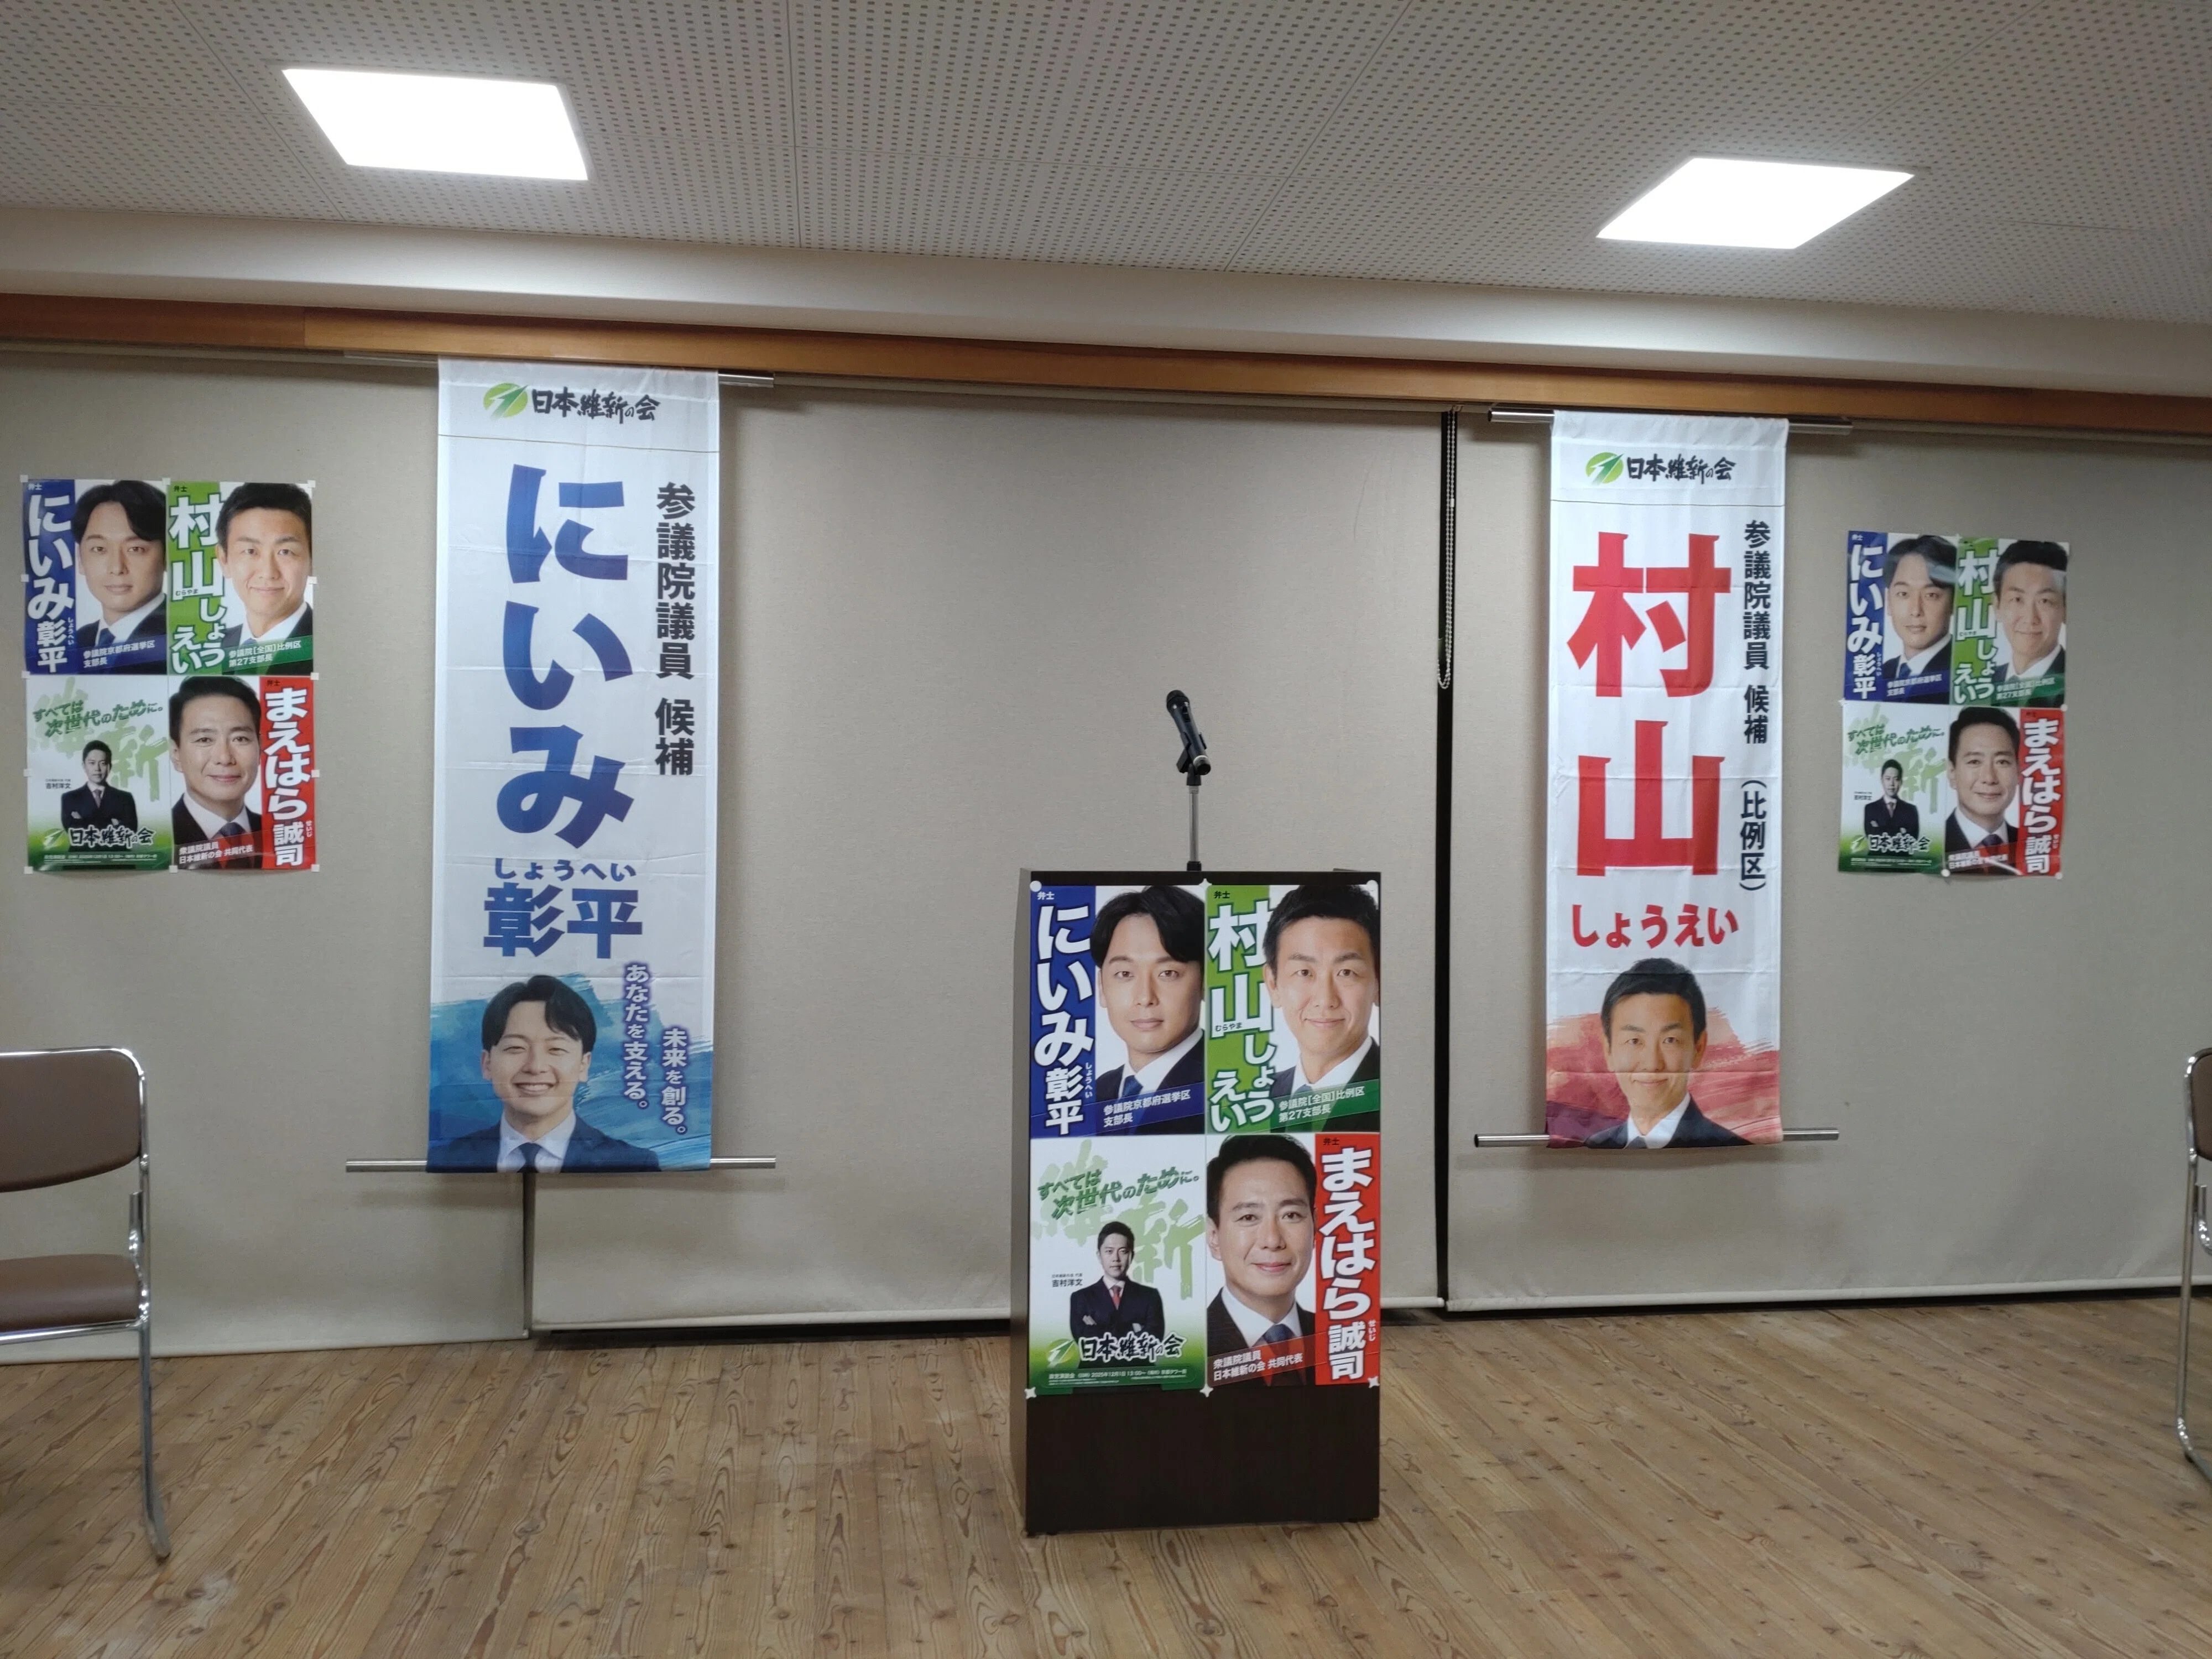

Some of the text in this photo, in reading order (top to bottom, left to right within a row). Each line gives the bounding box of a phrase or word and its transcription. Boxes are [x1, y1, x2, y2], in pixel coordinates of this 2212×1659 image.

[531, 387, 661, 424] 日本維新の会
[1626, 453, 1736, 484] 日本維新の会
[1743, 520, 1771, 671] 参議院議員
[655, 482, 695, 775] 参議院議員 候補
[84, 656, 107, 668] 支部長
[497, 463, 634, 849] にいみ
[1566, 531, 1732, 876] 村山
[1744, 685, 1769, 744] 候補
[69, 825, 157, 848] 日本維新の会
[494, 858, 636, 881] しょうへい
[1037, 891, 1055, 900] 弁士
[1214, 891, 1230, 899] 弁士
[483, 882, 643, 959] 彰平
[1572, 904, 1739, 948] しょうえい
[624, 963, 649, 1109] あなたを支える。
[1215, 1022, 1241, 1031] むらやま
[662, 1027, 687, 1134] 未来を創る。
[1103, 1089, 1190, 1116] 参議院京都府選挙区
[1279, 1106, 1331, 1123] 第27支部長
[1104, 1115, 1133, 1128] 支部長
[1323, 1138, 1339, 1146] 弁士
[1079, 1332, 1187, 1363] 日本維新の会
[1213, 1350, 1261, 1370] 衆議院議員
[1213, 1353, 1303, 1381] 日本維新の会 共同代表
